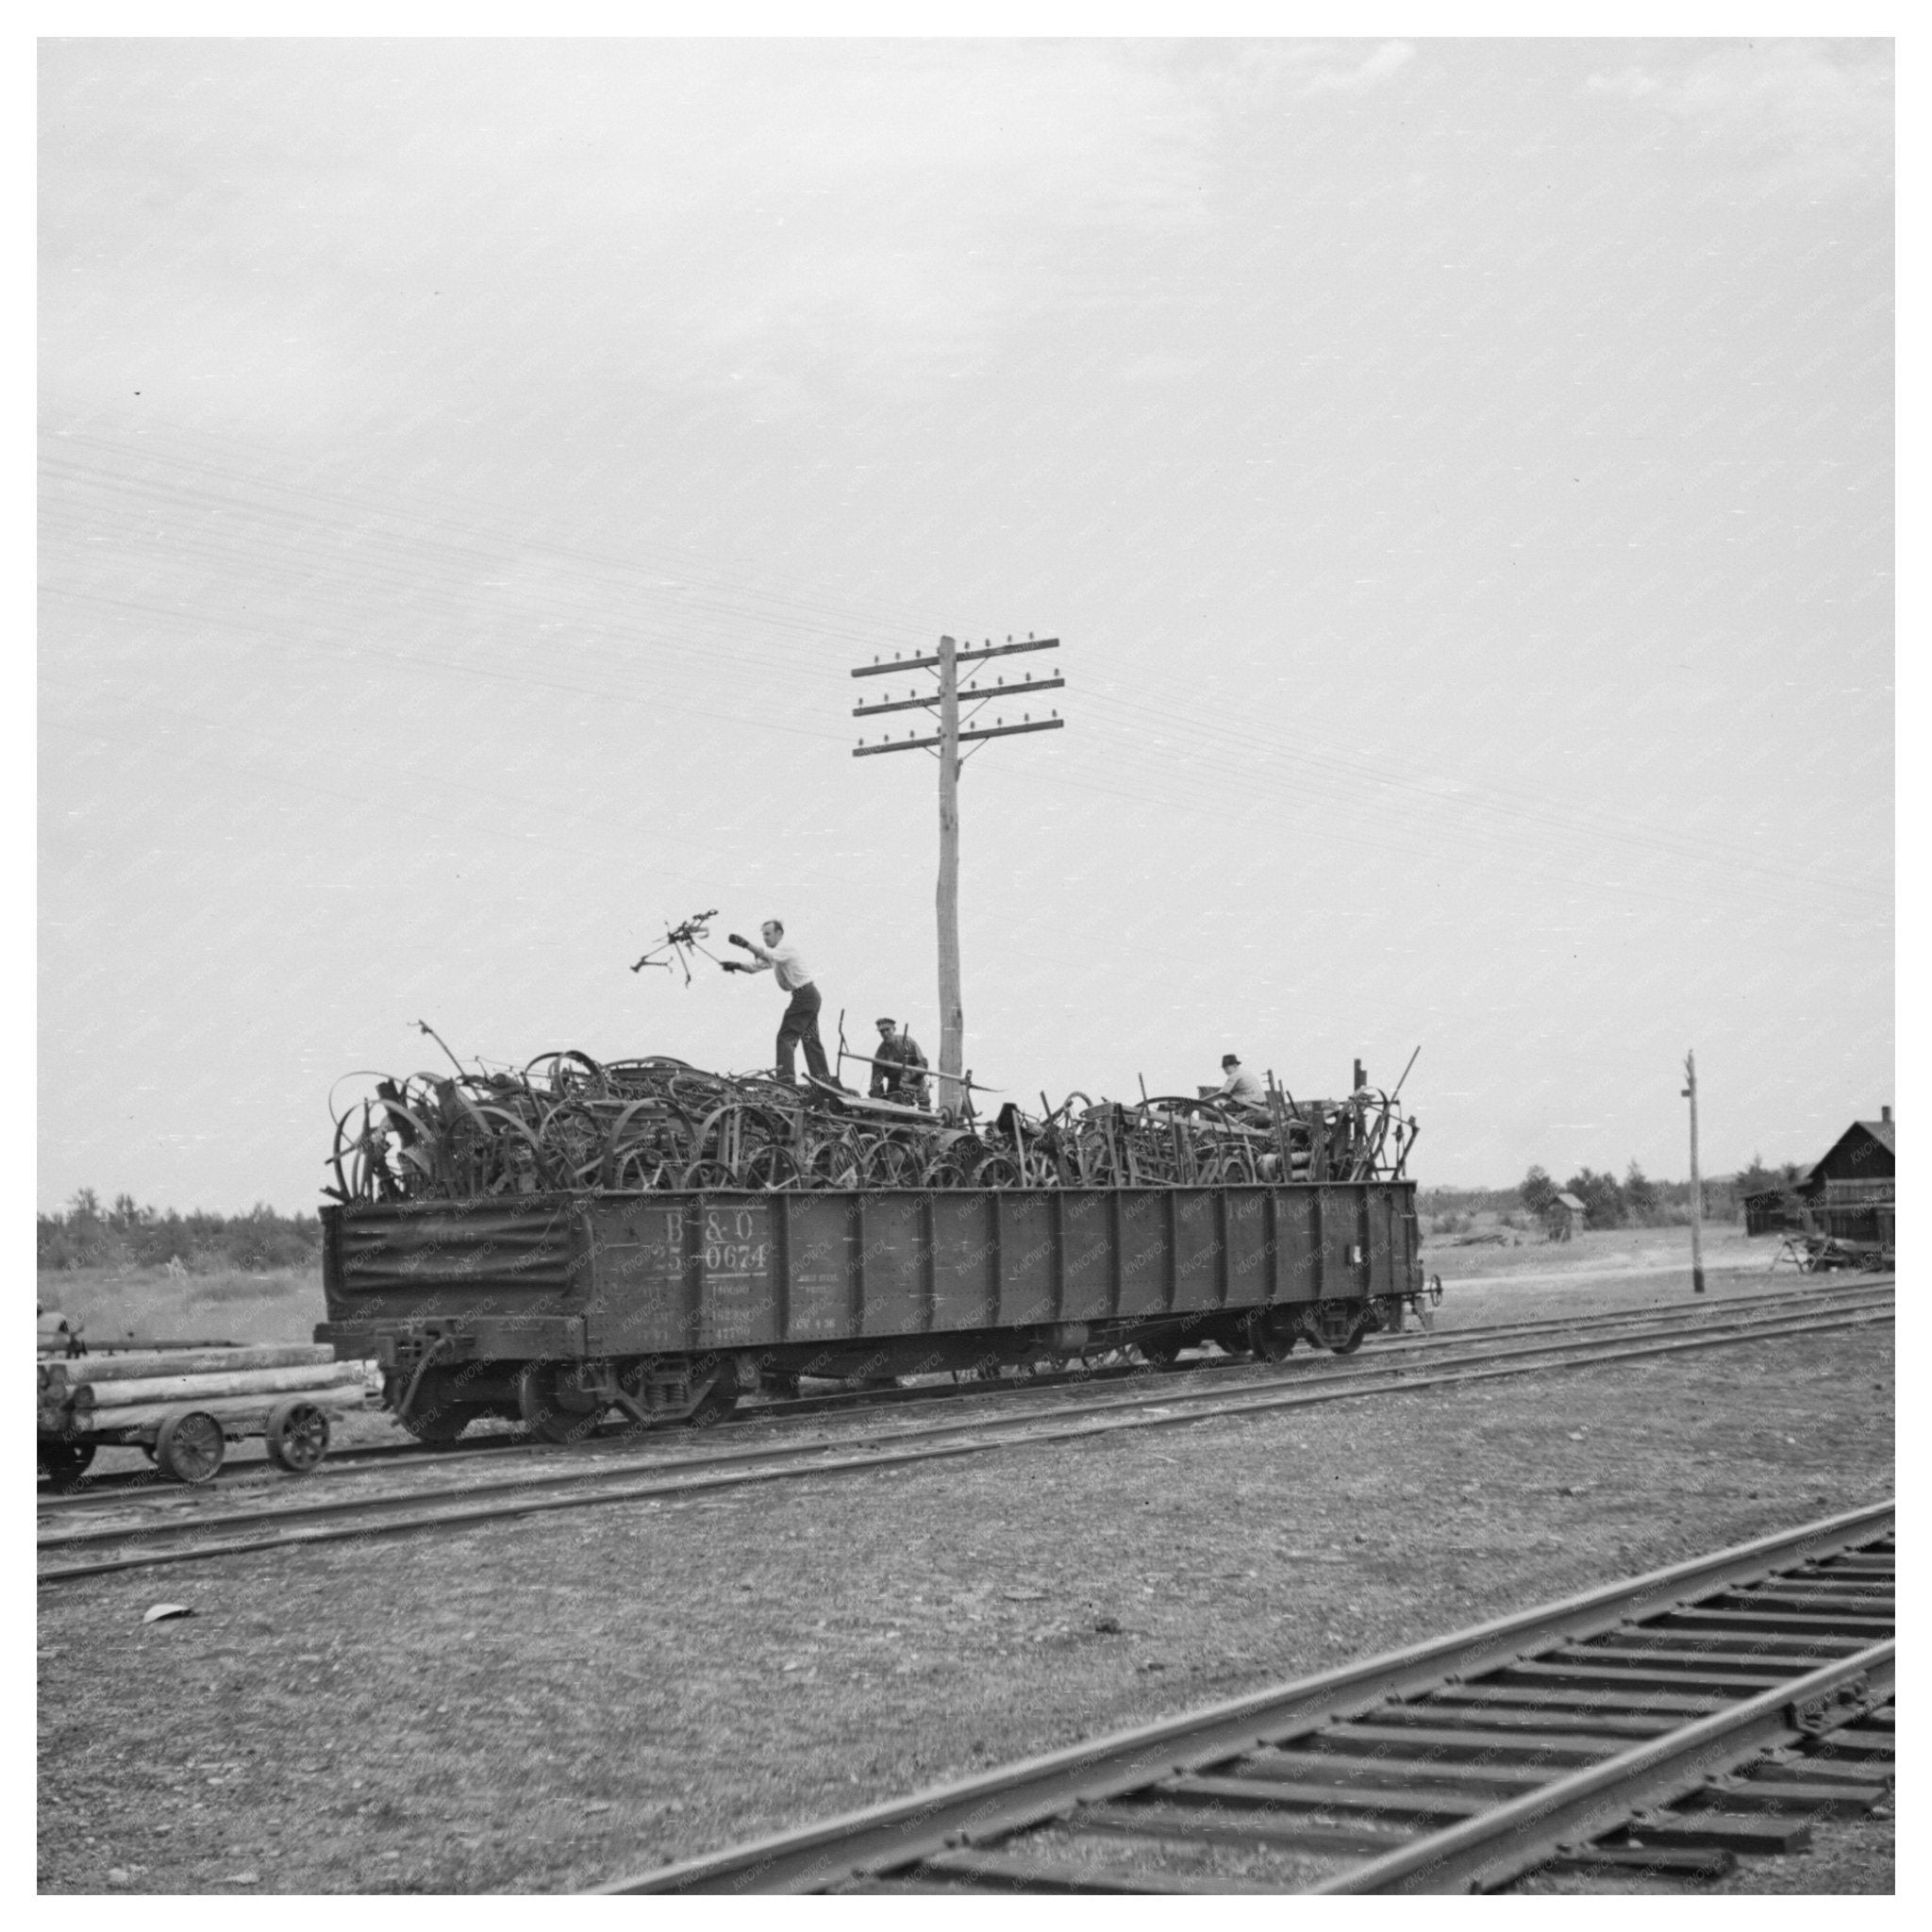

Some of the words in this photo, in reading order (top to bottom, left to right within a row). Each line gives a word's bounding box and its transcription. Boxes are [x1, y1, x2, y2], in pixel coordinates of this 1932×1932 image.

[666, 1213, 683, 1241] B
[706, 1212, 728, 1241] &
[736, 1211, 753, 1240] O
